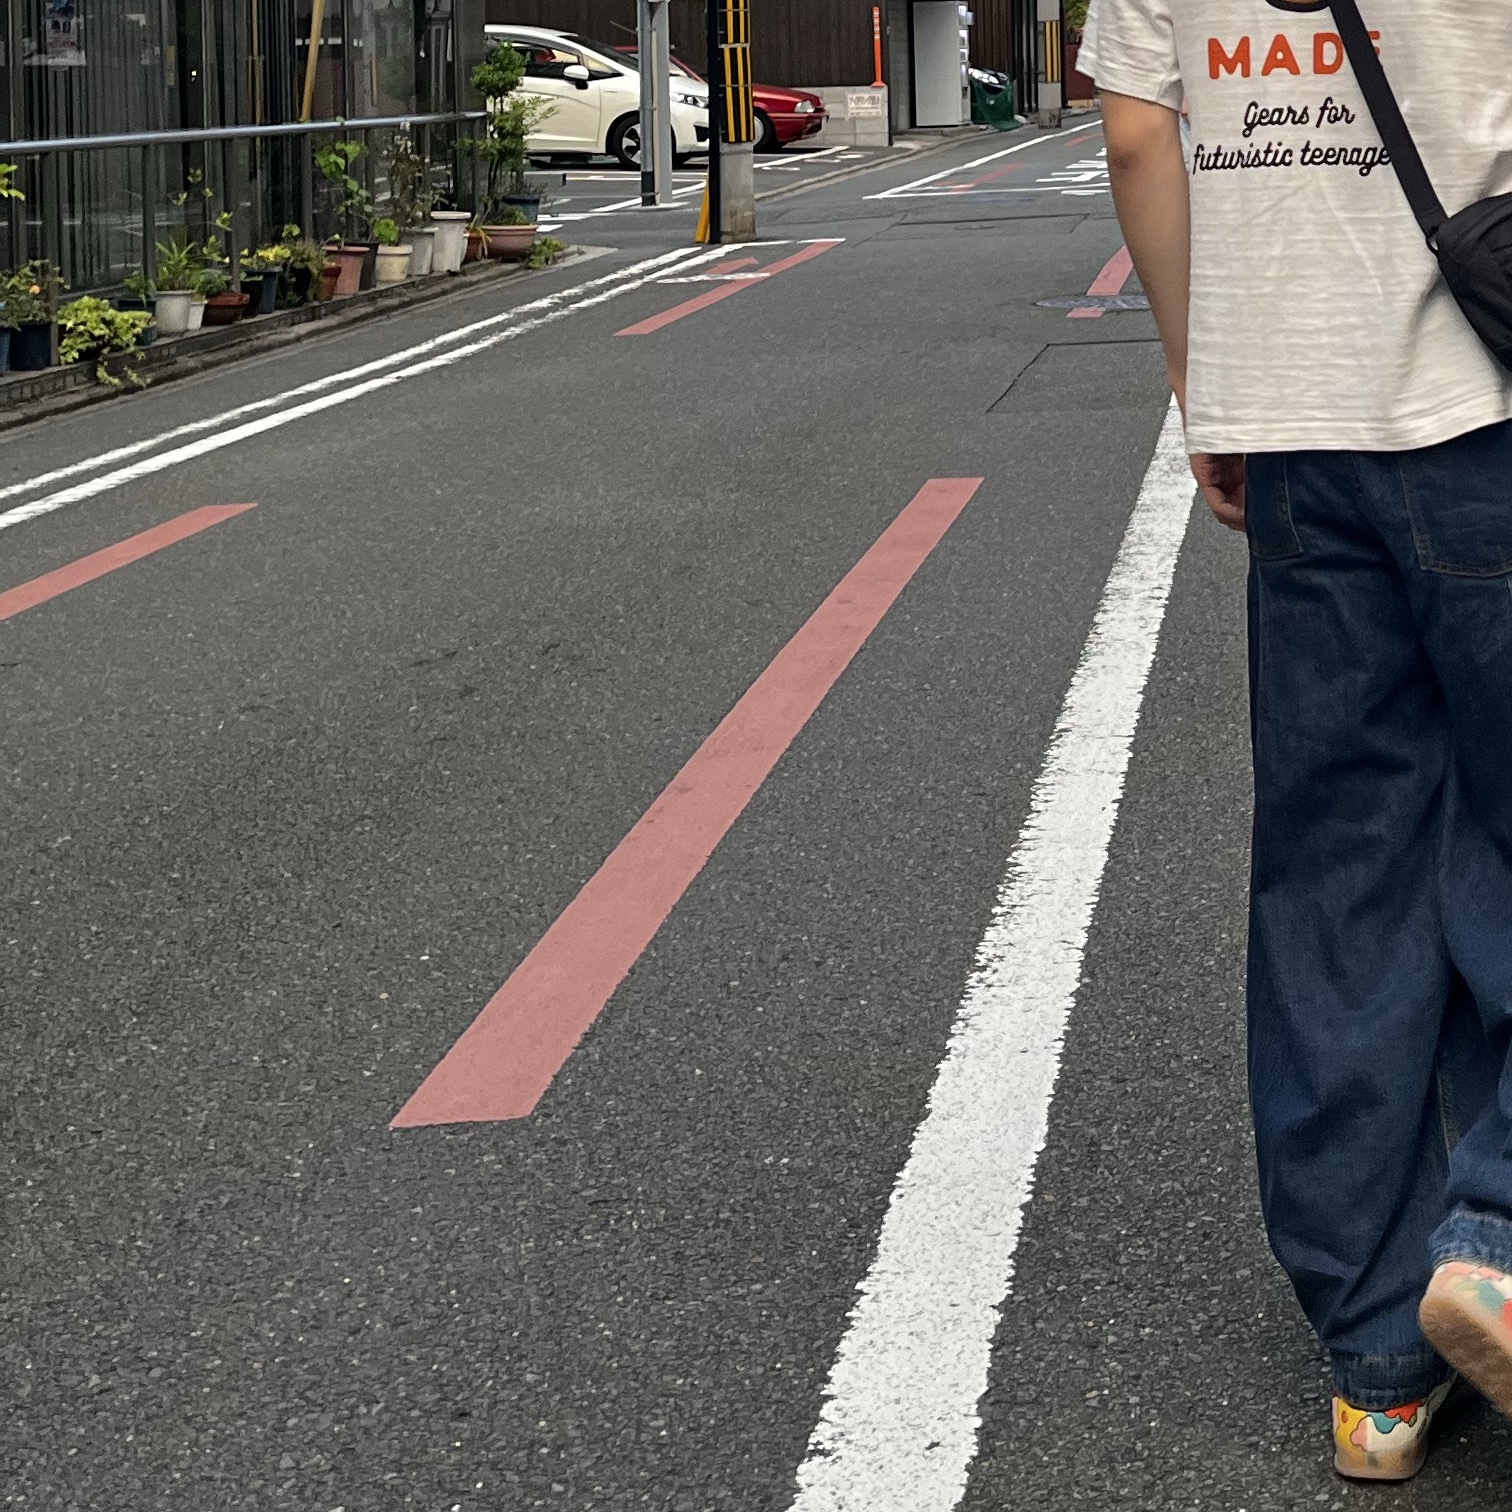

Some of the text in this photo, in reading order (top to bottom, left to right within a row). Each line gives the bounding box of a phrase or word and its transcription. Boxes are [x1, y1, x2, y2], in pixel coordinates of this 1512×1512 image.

[1242, 96, 1356, 138] Gears for
[1192, 140, 1392, 176] futuristic teenage
